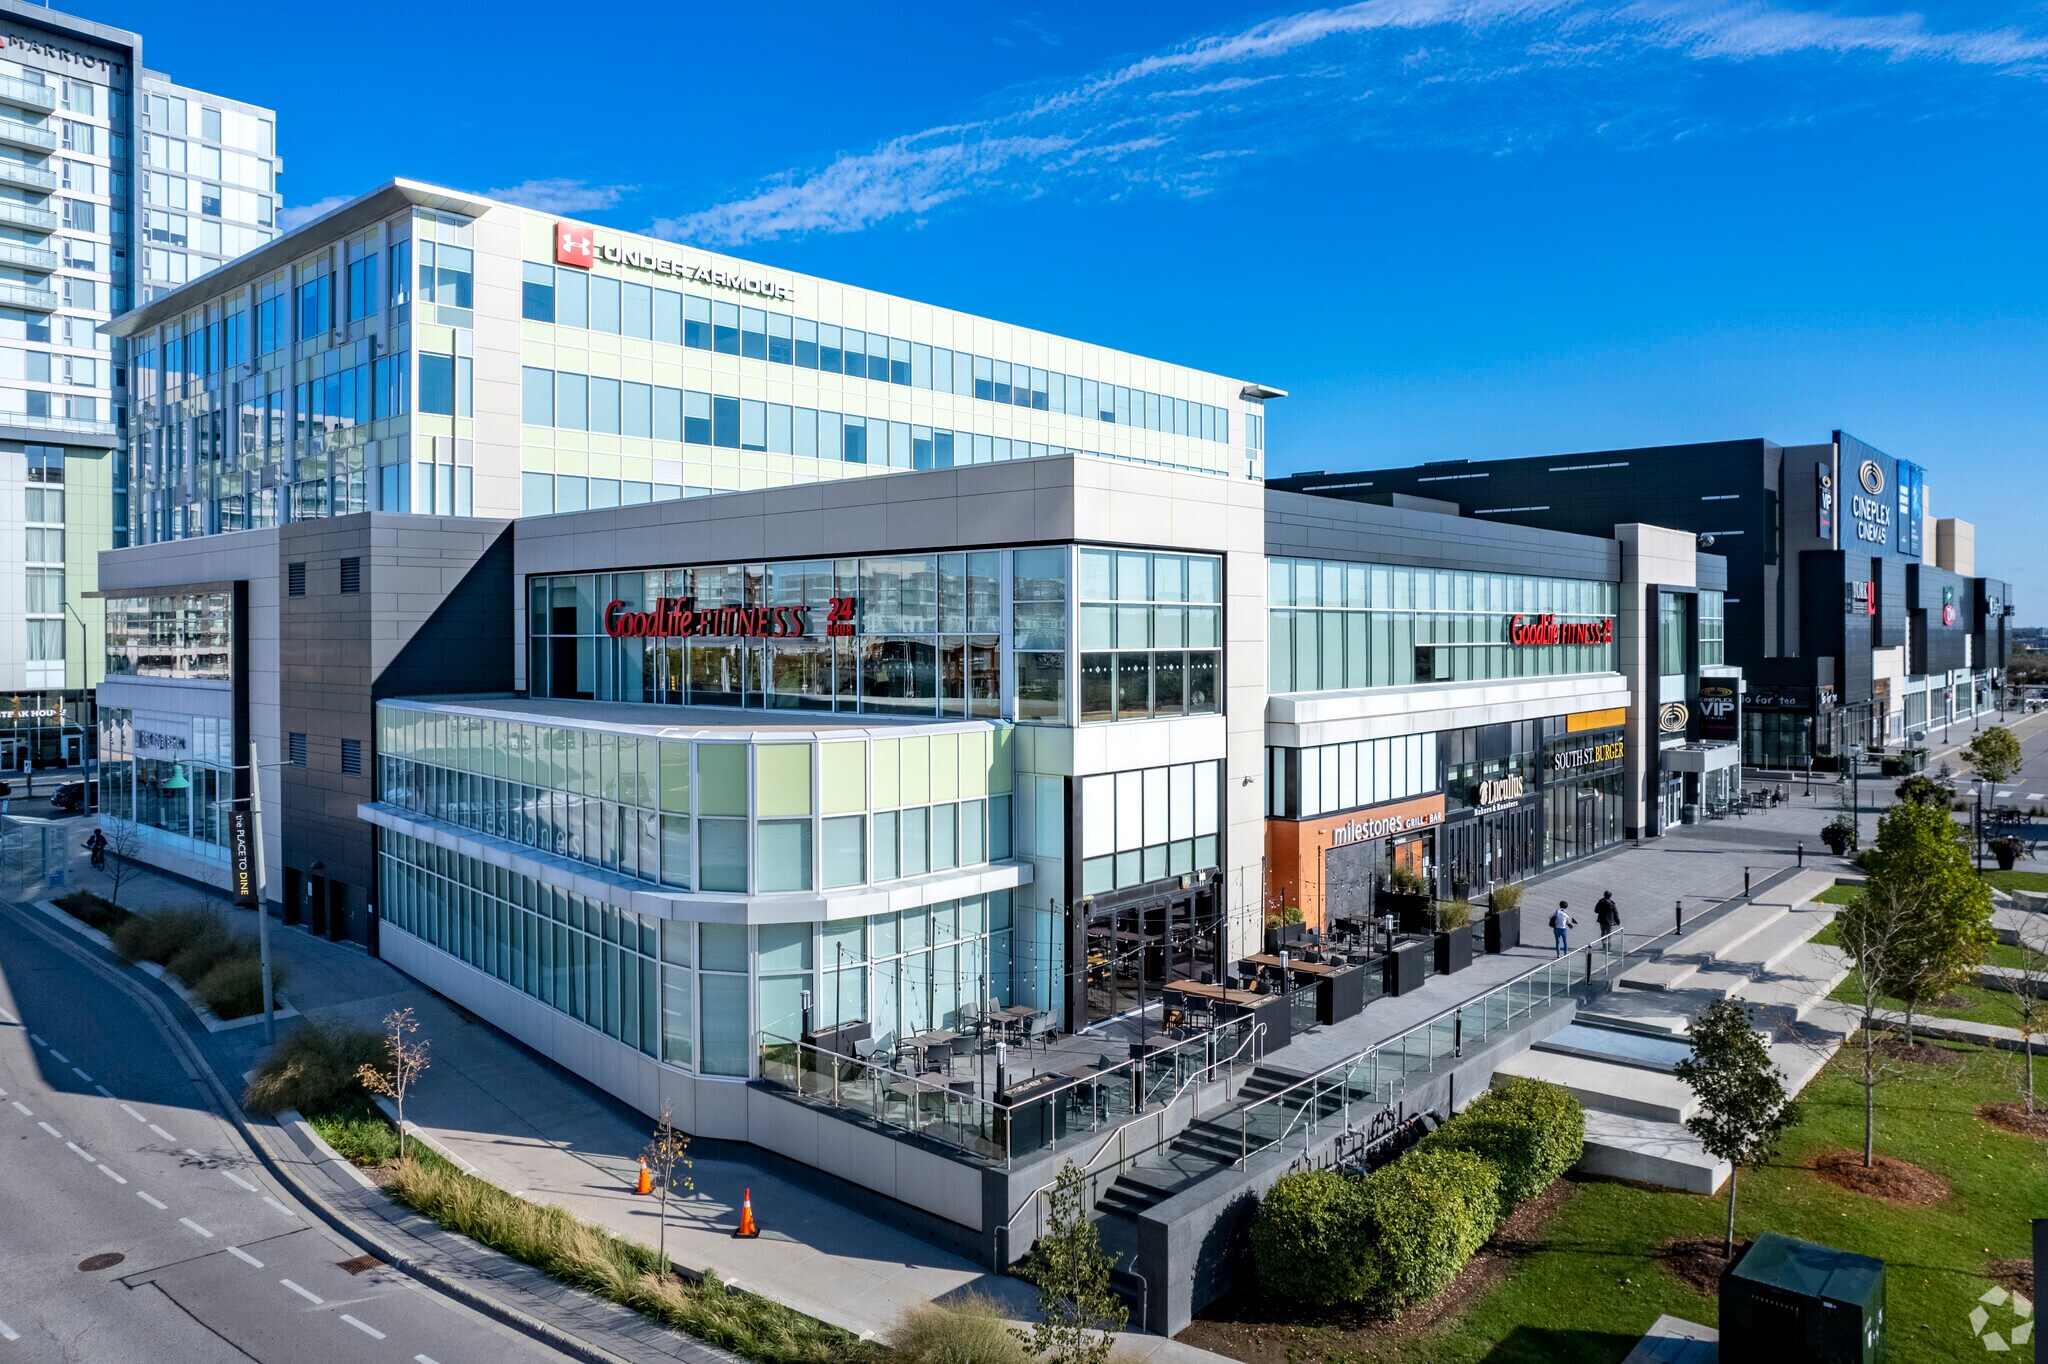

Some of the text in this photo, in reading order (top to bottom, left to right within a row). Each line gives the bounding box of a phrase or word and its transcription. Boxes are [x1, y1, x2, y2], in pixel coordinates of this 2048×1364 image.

[9, 34, 124, 75] MARRIOTT
[596, 245, 794, 302] UNDER ARMOUR
[1853, 495, 1890, 527] CINEPLEX
[1858, 521, 1886, 544] CINEMAS
[1853, 581, 1868, 599] YORK
[604, 596, 853, 638] GoodLife FITNESS 24
[826, 624, 853, 637] HOUR
[1512, 613, 1559, 645] GoodLife
[1561, 623, 1601, 645] FITNESS
[1699, 702, 1735, 717] VIP
[1755, 694, 1774, 705] for
[1779, 696, 1796, 705] tea
[1555, 751, 1583, 771] SOUTH
[1595, 742, 1624, 763] BURGER
[1488, 773, 1523, 804] Lucullus
[1474, 806, 1492, 817] Bakers
[1335, 816, 1402, 846] milestones
[1406, 816, 1424, 829] GRILL
[1430, 812, 1442, 823] BAR
[235, 814, 248, 895] the PLACE TO DINE
